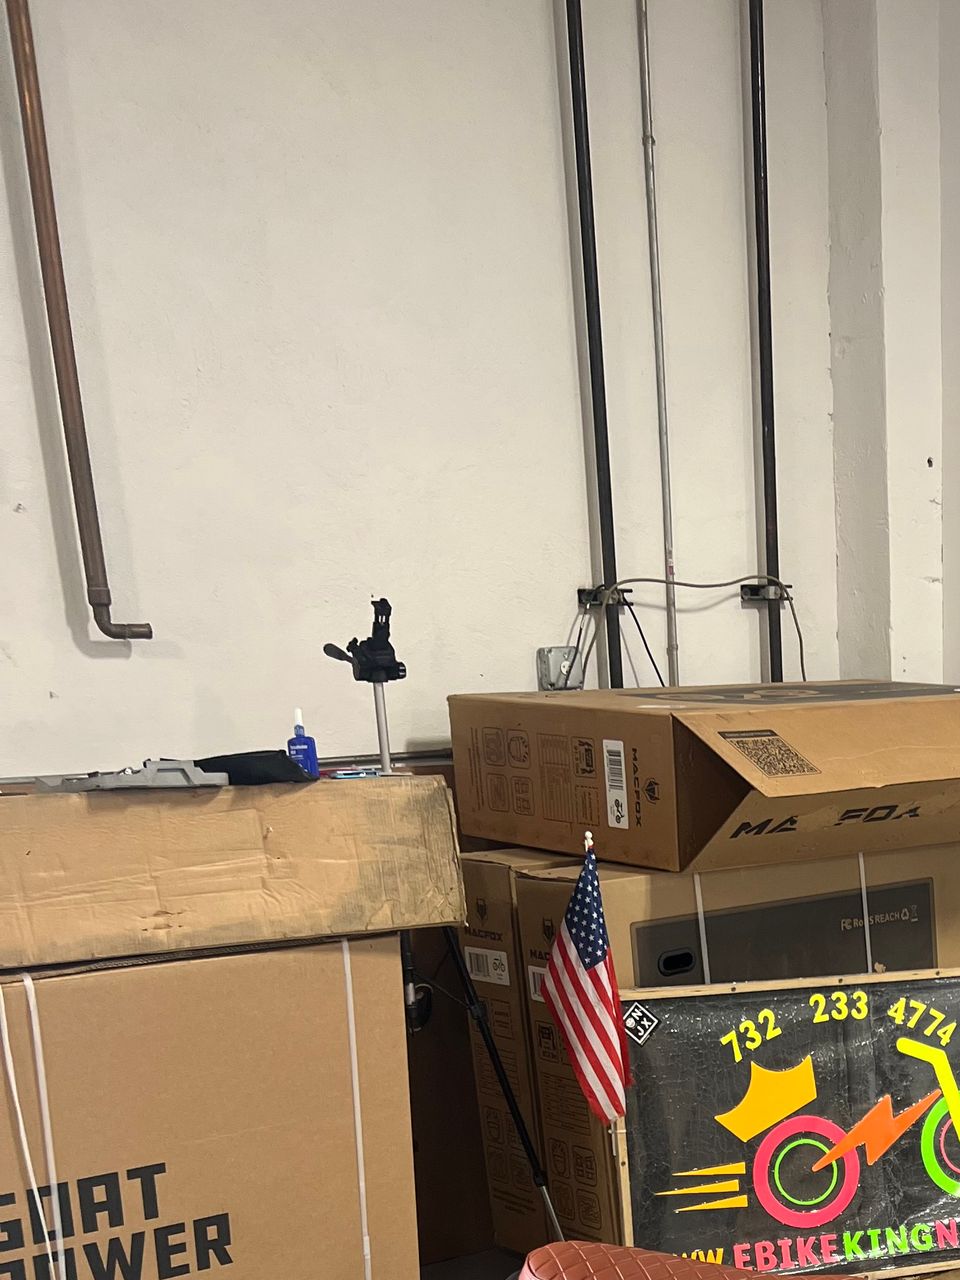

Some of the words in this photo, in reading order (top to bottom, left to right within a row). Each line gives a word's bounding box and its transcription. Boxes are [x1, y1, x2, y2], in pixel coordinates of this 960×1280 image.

[631, 747, 642, 827] MACFOX
[729, 804, 921, 839] MAFOX
[853, 915, 874, 928] RoS
[874, 911, 900, 924] REACH
[720, 1008, 783, 1064] 732
[809, 991, 869, 1024] 233
[887, 996, 959, 1047] 4774
